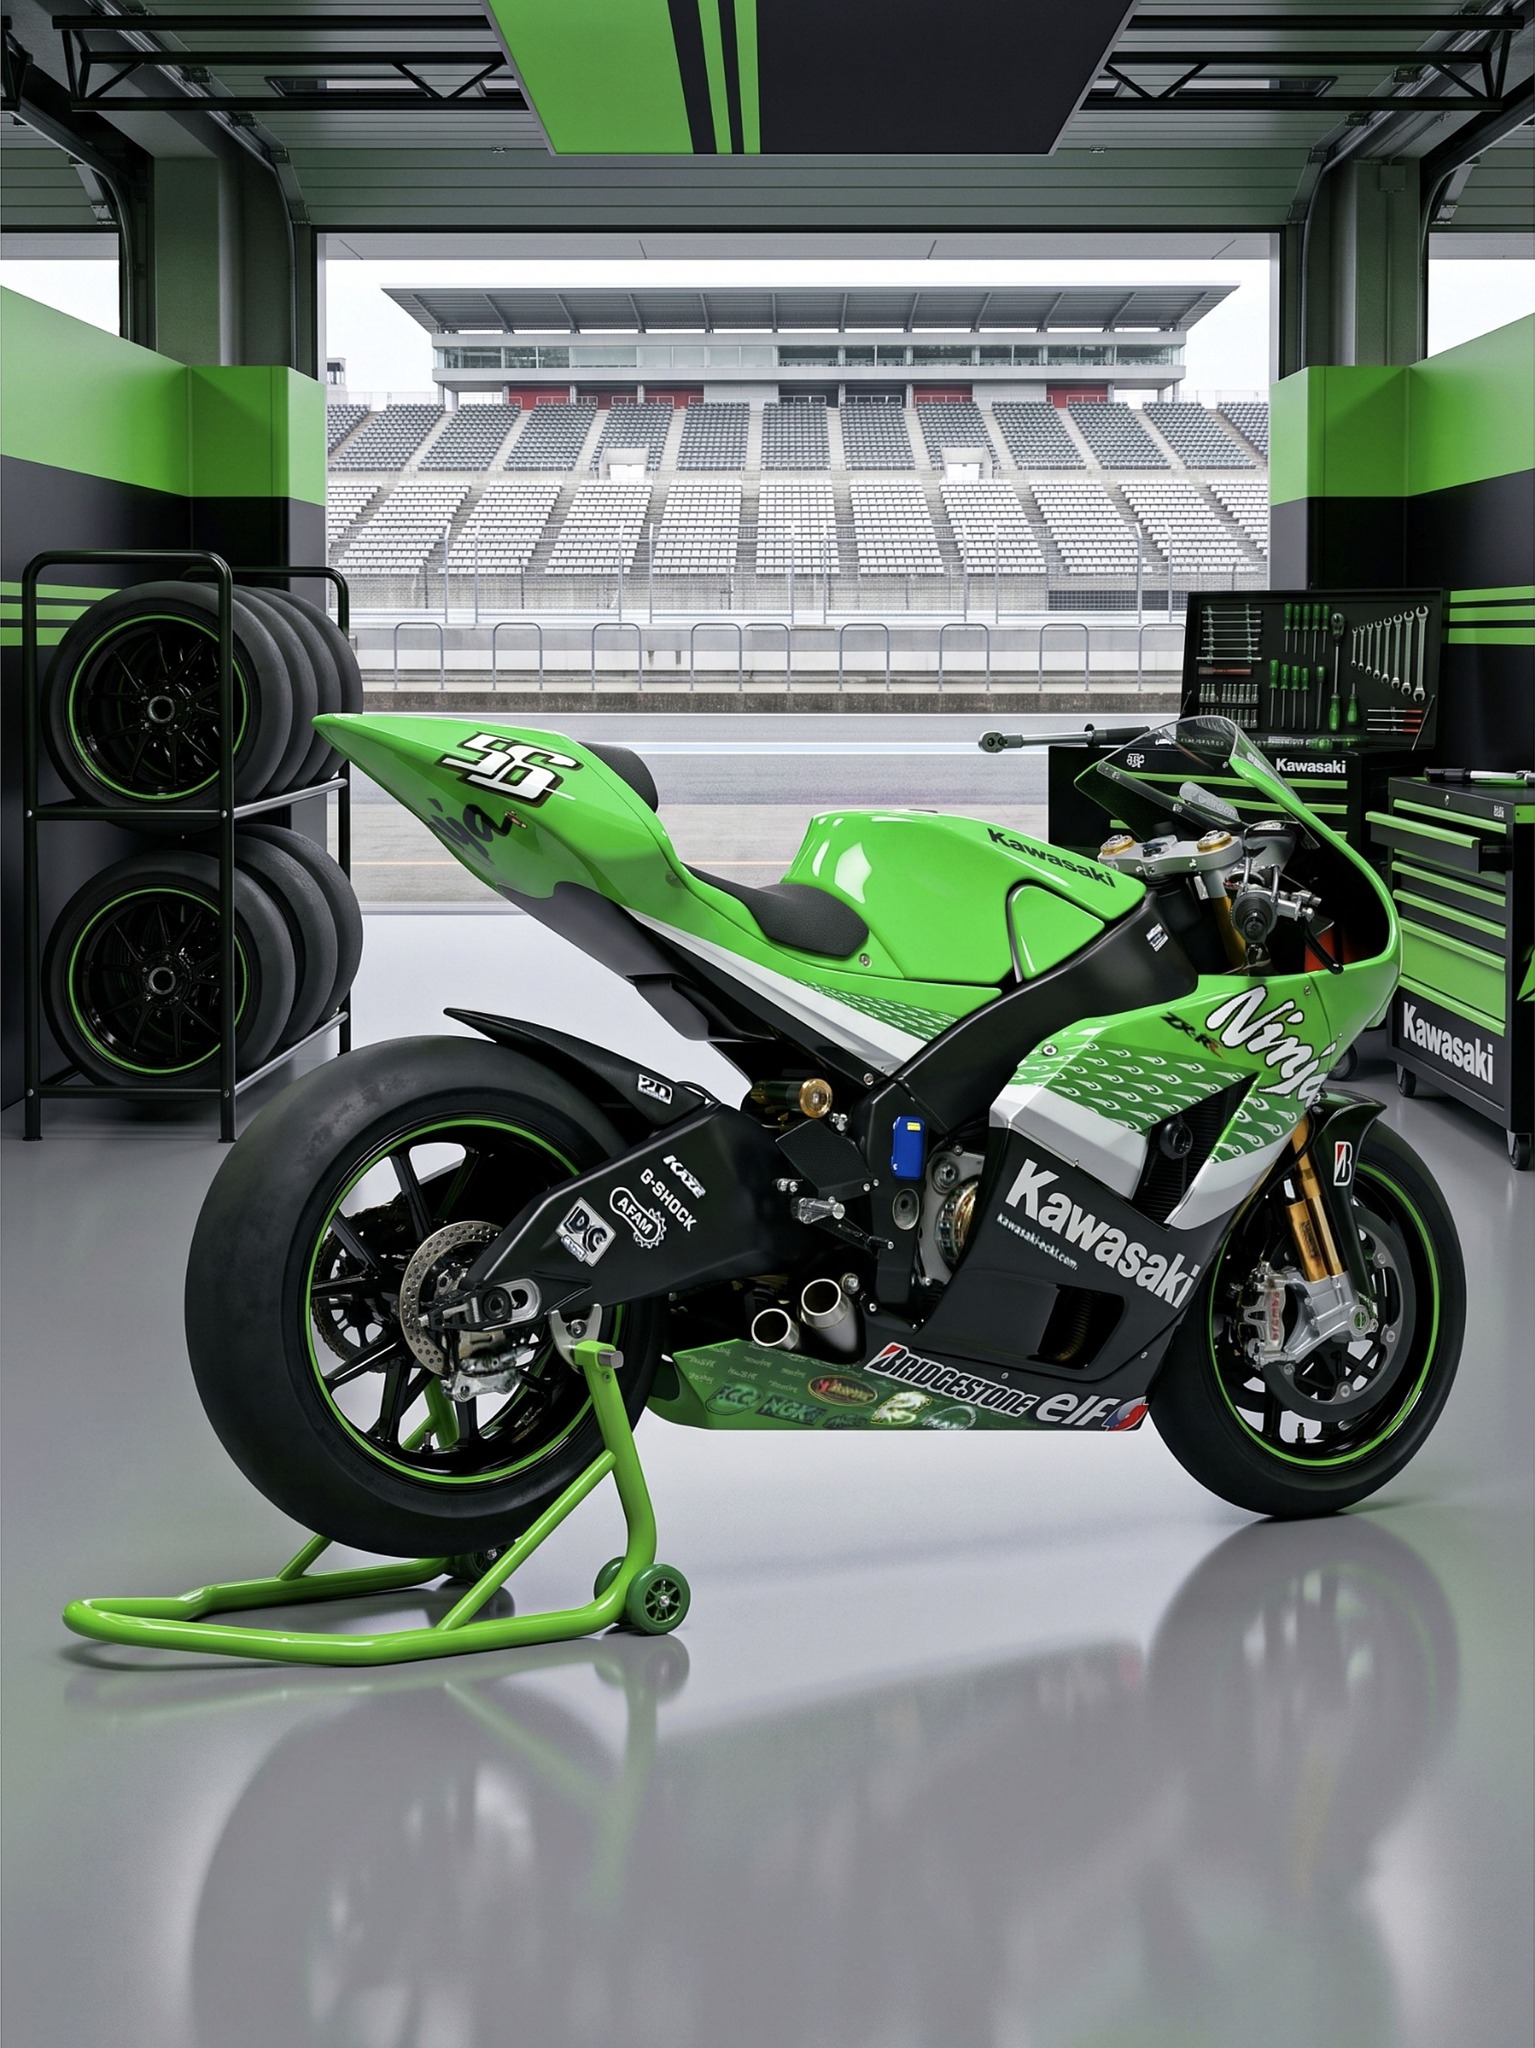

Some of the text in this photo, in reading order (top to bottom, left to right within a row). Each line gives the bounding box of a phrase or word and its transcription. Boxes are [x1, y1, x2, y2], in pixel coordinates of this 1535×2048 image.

[434, 731, 584, 808] 56
[1276, 758, 1347, 774] Kawasaki
[987, 828, 1116, 888] Kawasaki
[1205, 985, 1337, 1108] Ninja
[1404, 1001, 1494, 1085] Kawasaki
[640, 1168, 697, 1232] G-SHOCK
[663, 1155, 706, 1198] KAZE
[617, 1197, 653, 1235] AFAM
[1005, 1159, 1200, 1309] Kawasaki
[865, 1343, 1040, 1416] BRIDGESTONE
[1036, 1394, 1120, 1426] elf
